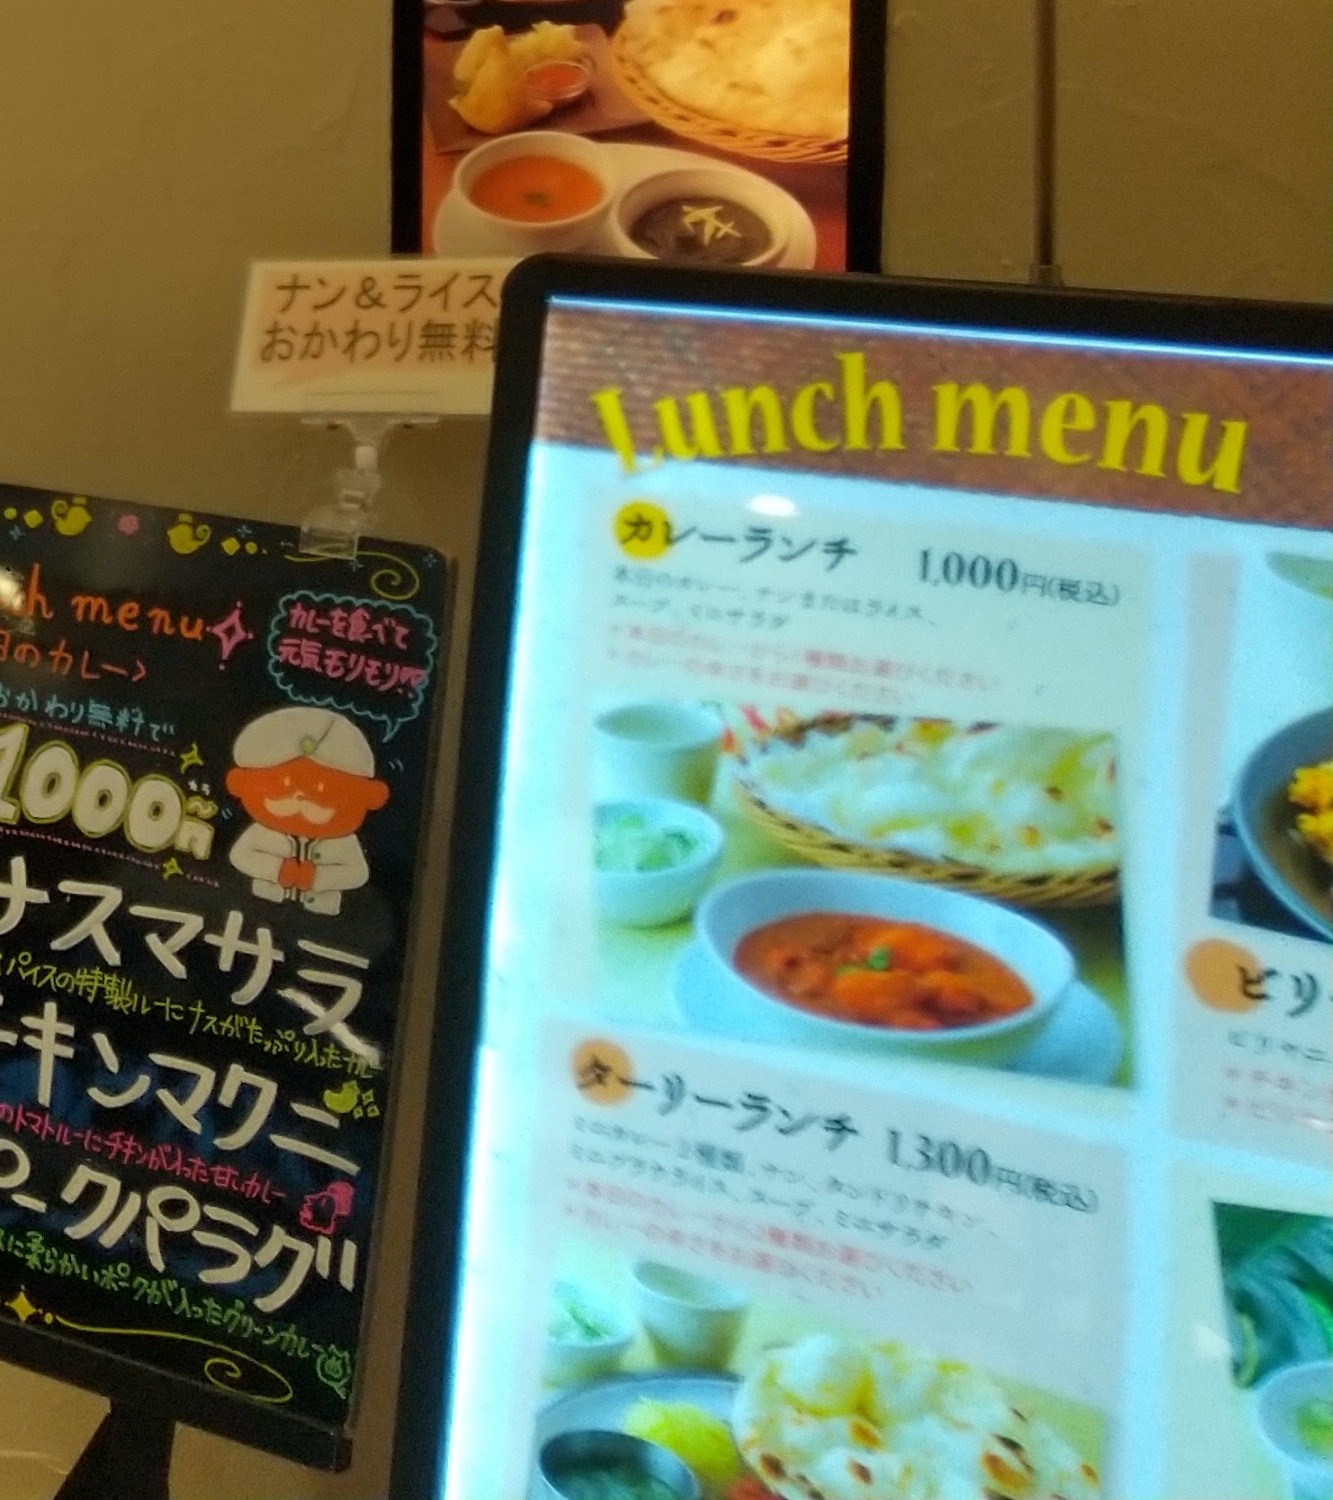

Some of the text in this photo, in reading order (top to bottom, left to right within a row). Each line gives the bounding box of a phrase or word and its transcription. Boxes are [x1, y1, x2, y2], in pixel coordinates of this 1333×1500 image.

[275, 272, 498, 313] ナン&ライス
[591, 351, 1250, 495] Lunch menu
[621, 512, 859, 572] カレーランチ
[71, 592, 205, 641] menu
[1235, 964, 1333, 1018] ビリ
[577, 1053, 860, 1152] ターリーランチ
